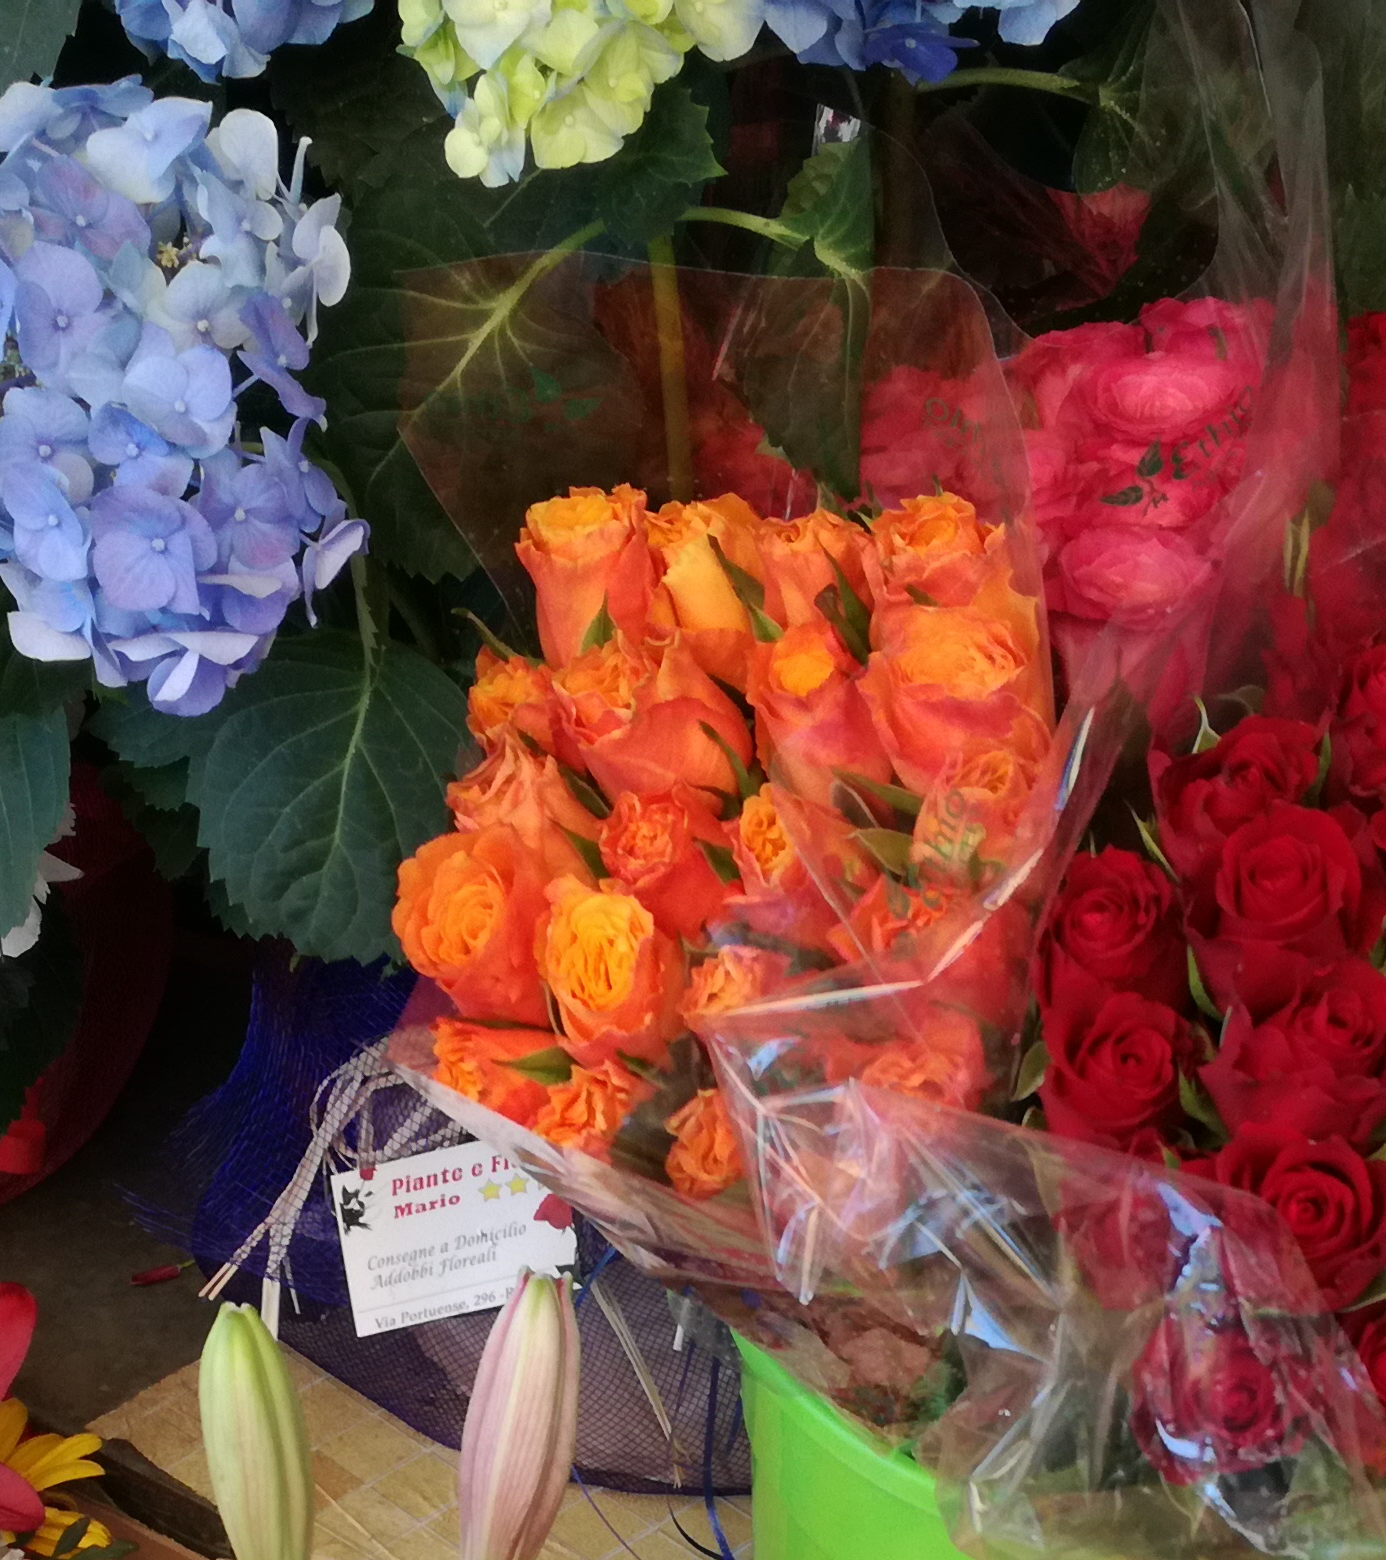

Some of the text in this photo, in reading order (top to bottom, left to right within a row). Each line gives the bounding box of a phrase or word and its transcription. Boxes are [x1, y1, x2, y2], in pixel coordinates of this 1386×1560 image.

[391, 1166, 463, 1196] Piante
[491, 1154, 517, 1173] Fi
[394, 1193, 461, 1219] Mario
[367, 1222, 527, 1271] Consegne a Domicilio
[371, 1247, 497, 1290] Addobbi Floreali
[375, 1316, 397, 1330] Via
[401, 1300, 470, 1325] Portuense,
[474, 1291, 497, 1307] 296
